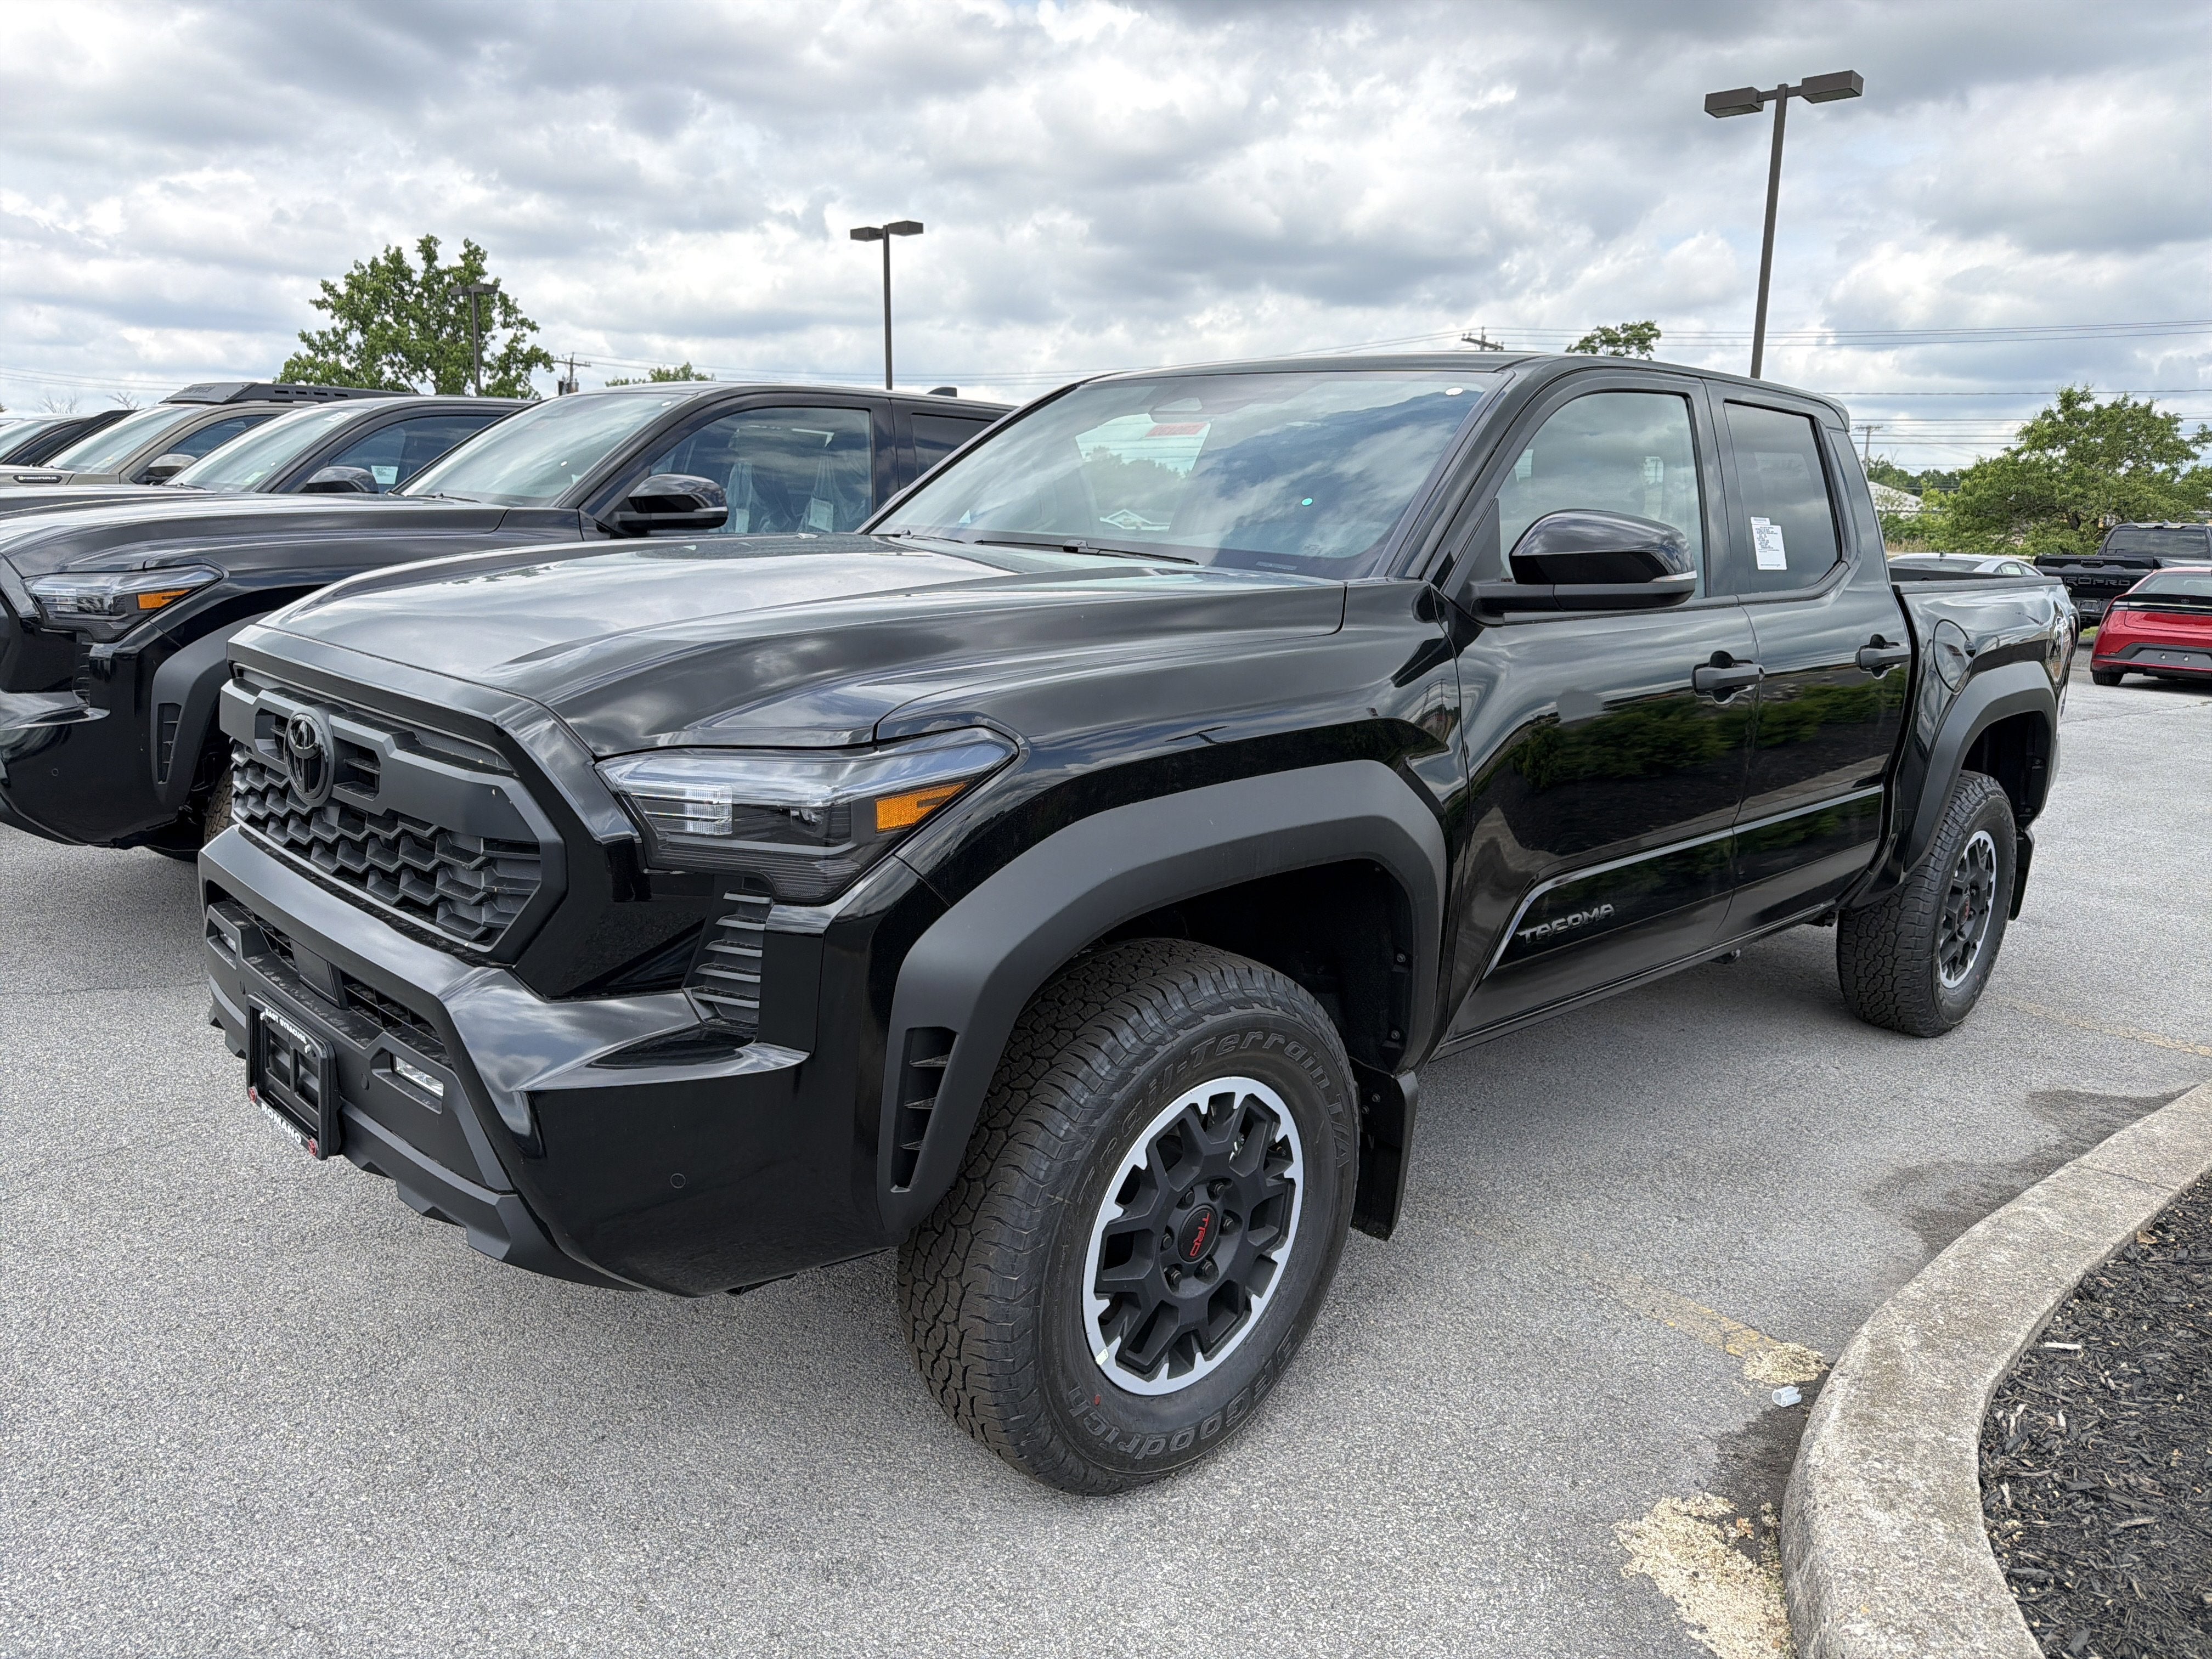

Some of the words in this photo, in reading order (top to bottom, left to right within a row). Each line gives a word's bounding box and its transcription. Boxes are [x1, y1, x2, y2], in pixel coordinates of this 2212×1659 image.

[1516, 903, 1615, 944] TACOMA
[265, 1008, 279, 1023] EAST
[279, 1018, 307, 1044] SYRACUSE
[261, 1102, 302, 1143] ROMANO
[1077, 1031, 1330, 1206] Trail-Terrain
[1327, 1093, 1351, 1169] T/A
[1189, 1212, 1210, 1256] TRD
[1068, 1324, 1299, 1460] BFGoodrich
